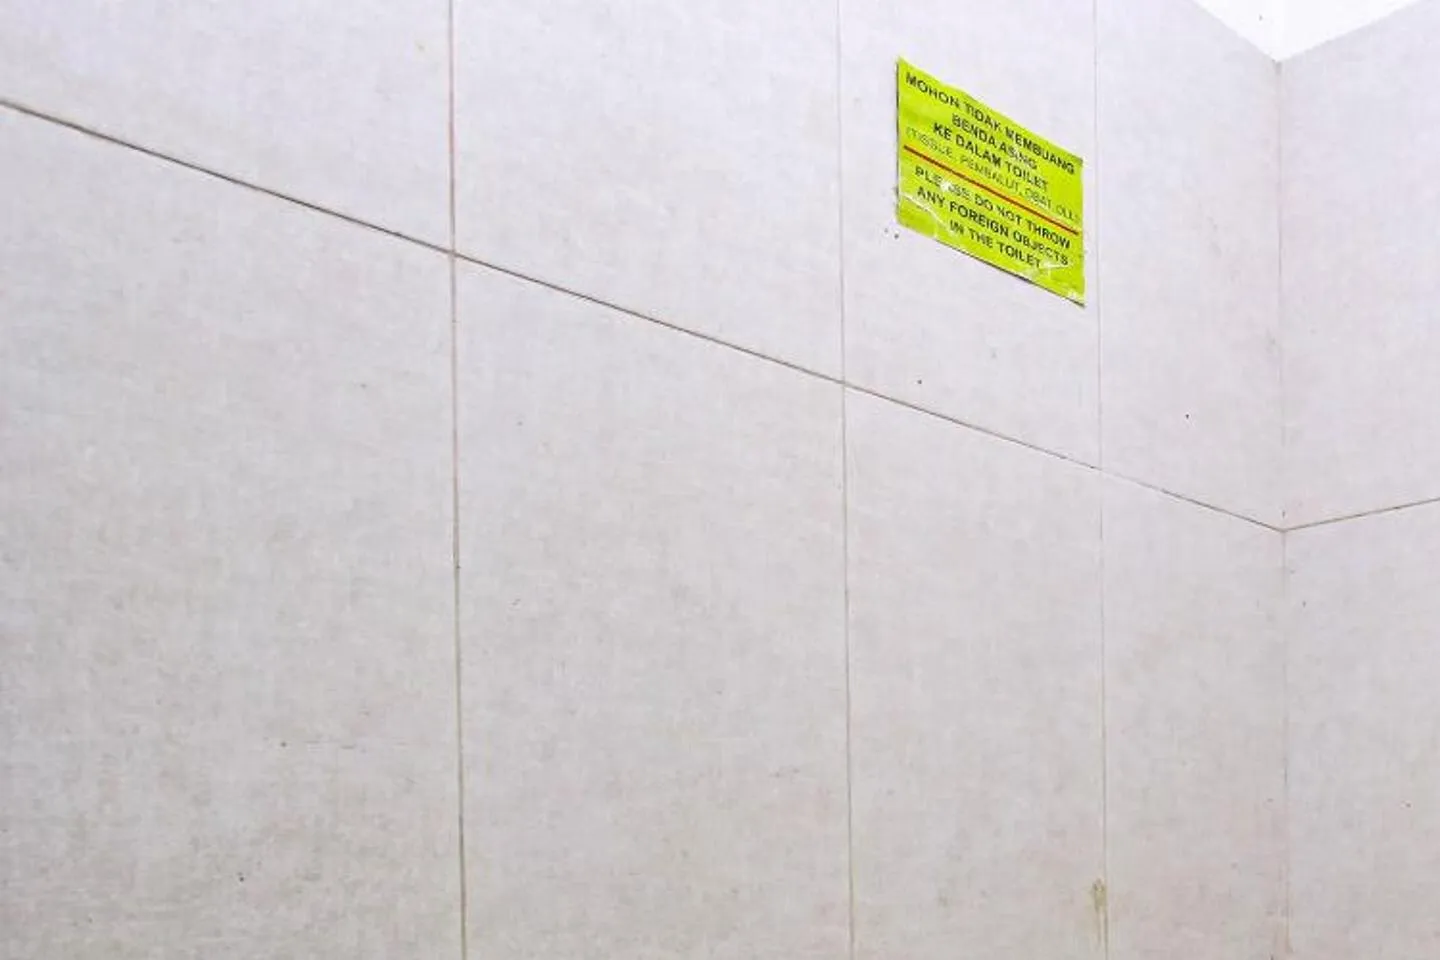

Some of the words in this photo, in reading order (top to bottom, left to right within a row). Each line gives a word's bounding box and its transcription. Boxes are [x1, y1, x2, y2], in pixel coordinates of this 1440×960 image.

[905, 70, 959, 111] MOHON
[963, 101, 1000, 134] TIDAK
[1004, 126, 1075, 176] MEMBUANG
[932, 120, 951, 142] KE
[955, 132, 1001, 169] DALAM
[1005, 160, 1048, 193] TOILET
[951, 112, 994, 148] BENDA
[999, 139, 1037, 171] ASING
[914, 164, 970, 202] PLESE
[974, 193, 992, 212] DO
[996, 203, 1022, 226] NOT
[1026, 218, 1070, 250] THROW
[917, 184, 945, 209] ANY
[949, 199, 1008, 238] FOREIGN
[1013, 229, 1068, 267] OBJECTS
[950, 218, 963, 235] IN
[968, 226, 993, 248] THE
[997, 240, 1041, 270] TOILET
